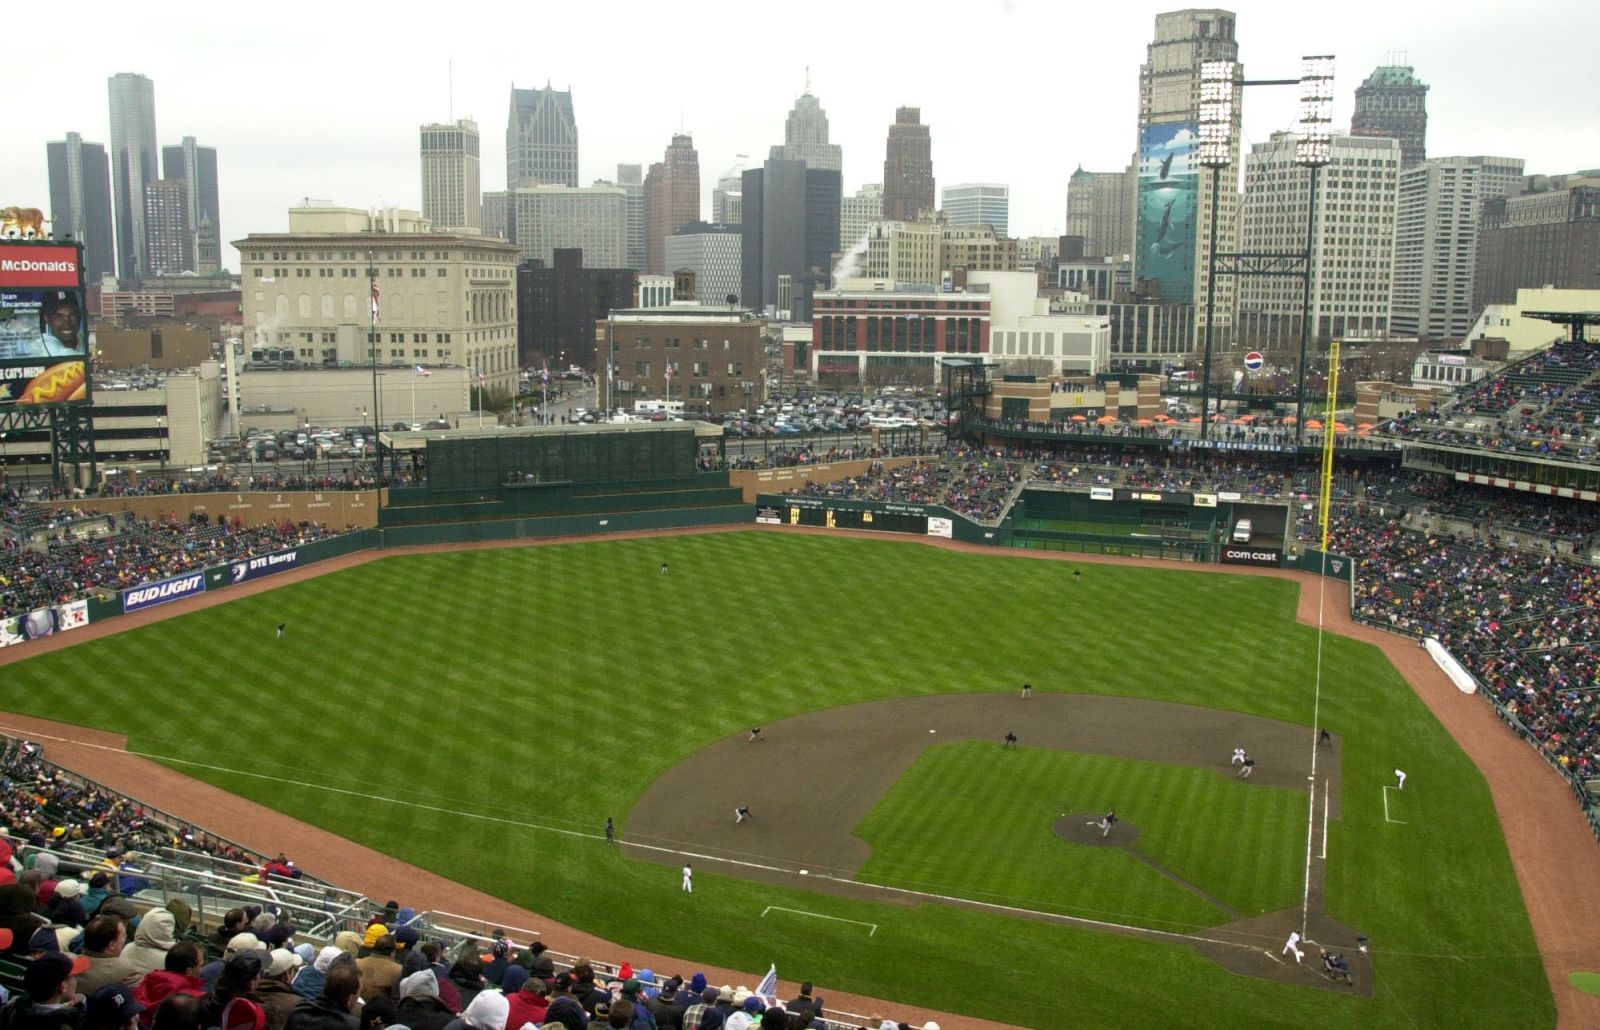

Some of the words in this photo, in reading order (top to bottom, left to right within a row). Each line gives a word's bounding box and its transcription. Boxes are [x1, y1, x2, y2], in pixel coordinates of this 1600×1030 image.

[1, 260, 75, 272] McDonald's
[249, 557, 267, 570] DTE
[269, 551, 297, 567] Energy
[126, 588, 160, 606] BUD
[160, 575, 202, 597] LIGHT
